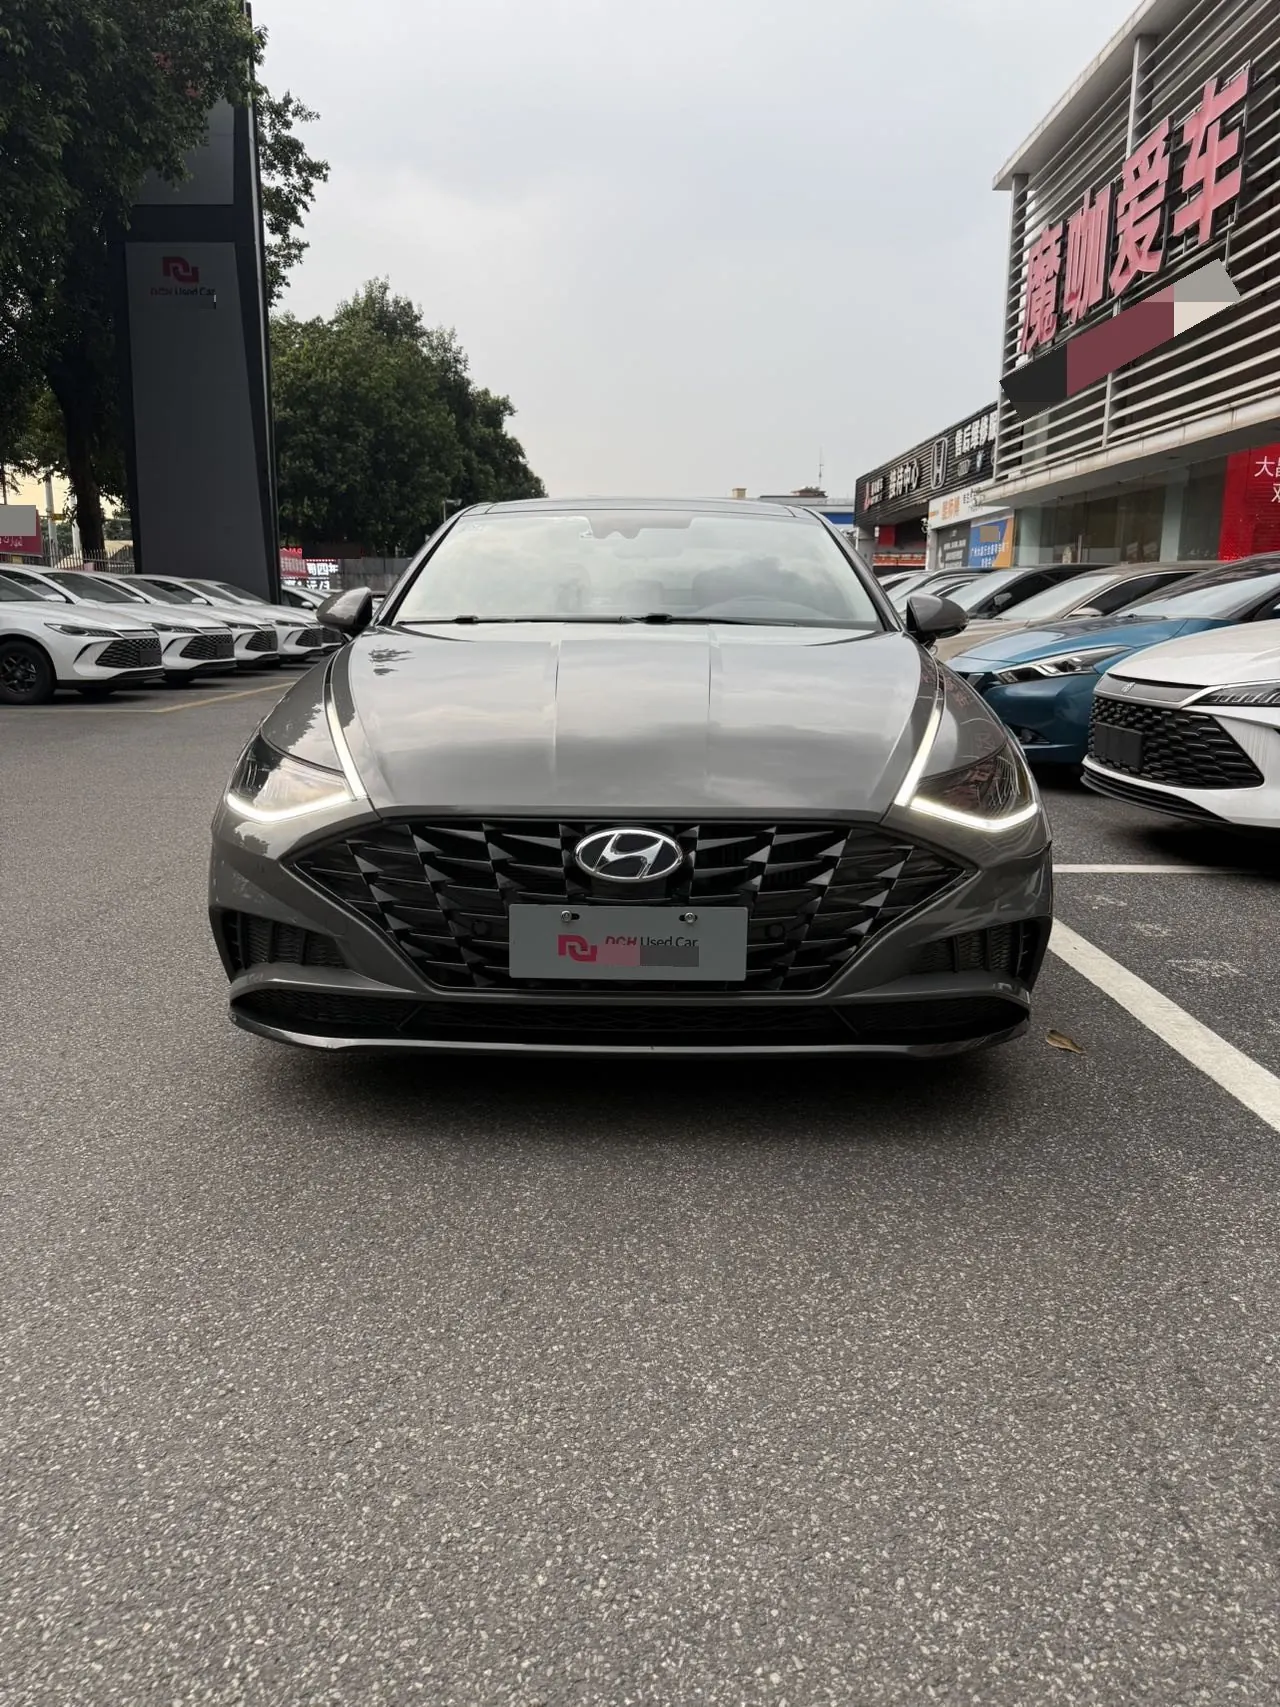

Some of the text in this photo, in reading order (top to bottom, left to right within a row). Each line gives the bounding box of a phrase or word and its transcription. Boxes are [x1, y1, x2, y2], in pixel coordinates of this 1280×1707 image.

[1020, 60, 1251, 355] 魔咖爱车
[1254, 455, 1280, 478] 大
